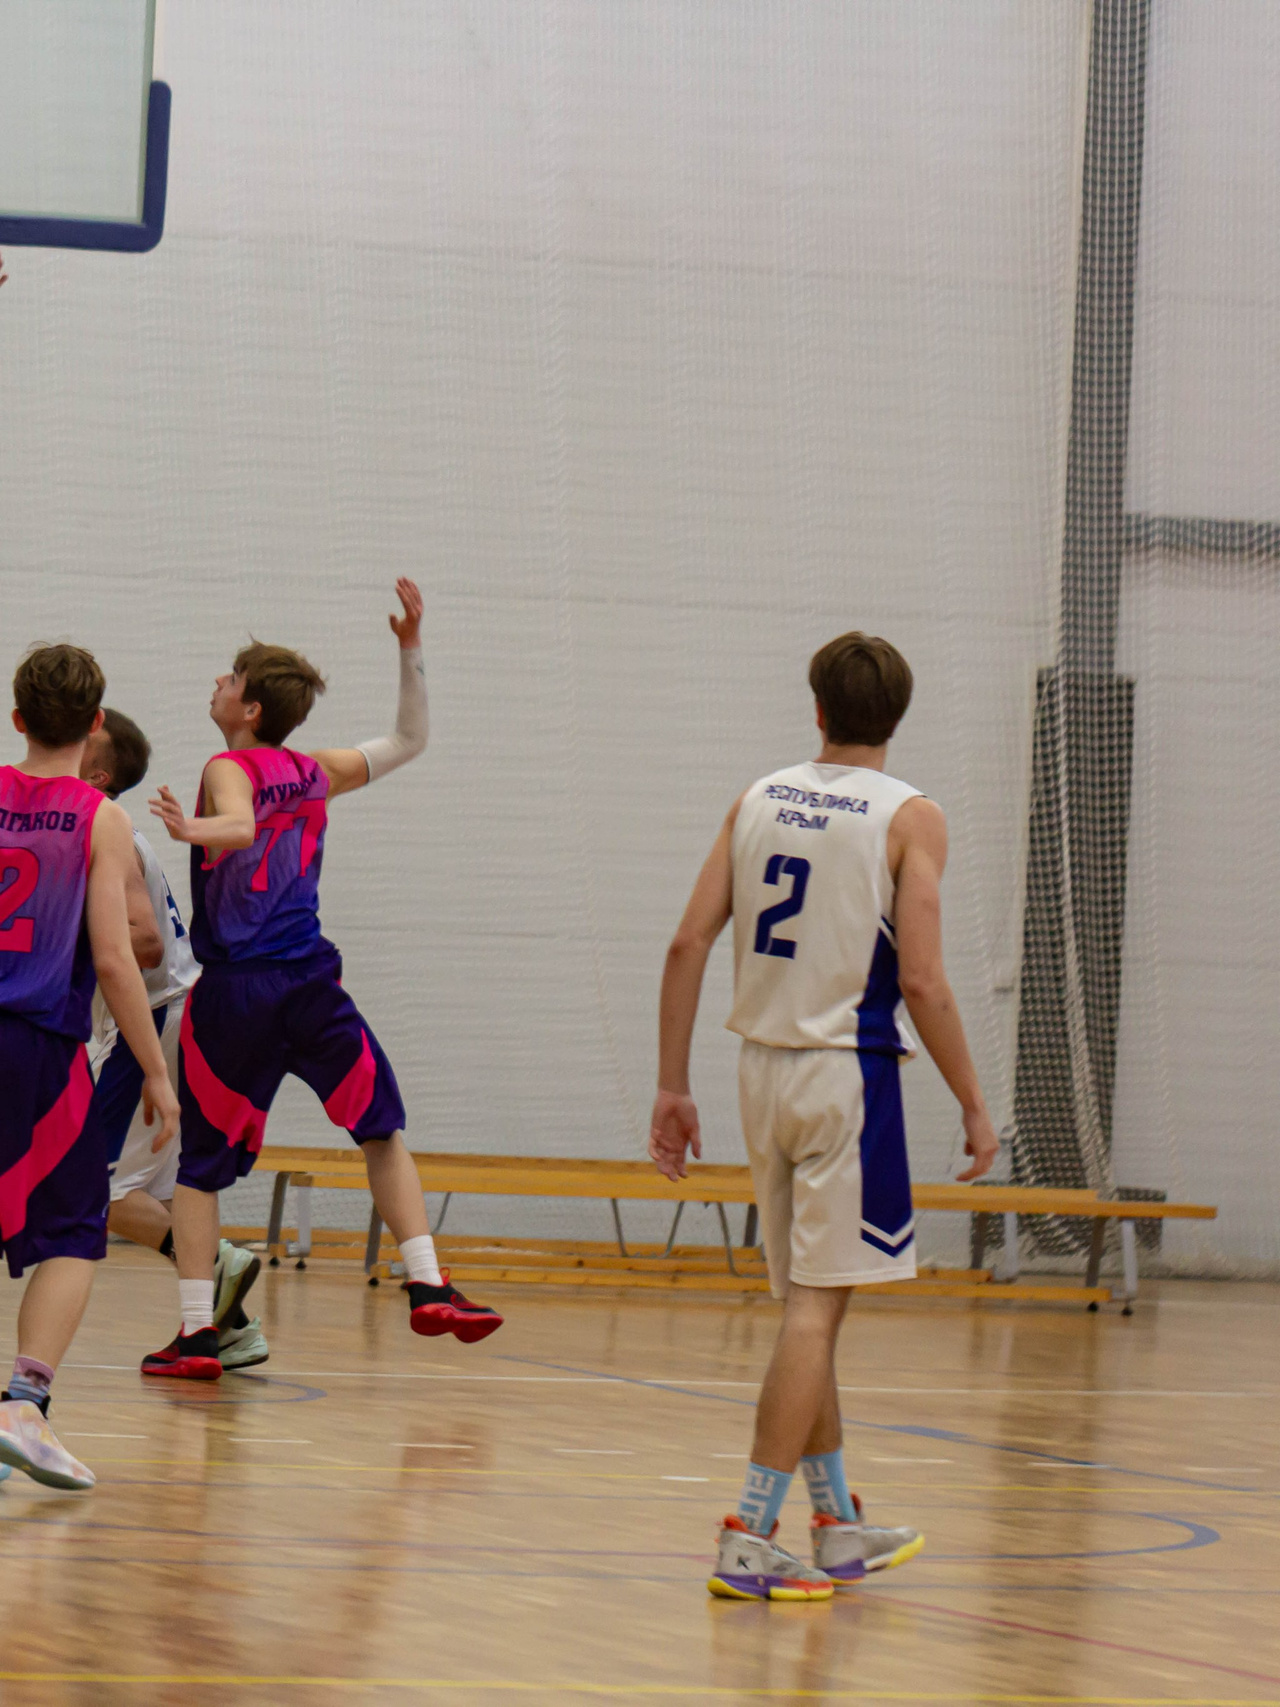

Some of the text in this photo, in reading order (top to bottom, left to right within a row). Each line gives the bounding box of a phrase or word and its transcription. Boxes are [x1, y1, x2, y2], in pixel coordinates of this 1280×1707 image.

[251, 798, 328, 892] 77
[775, 807, 830, 831] КРЫМ
[753, 853, 812, 960] 2
